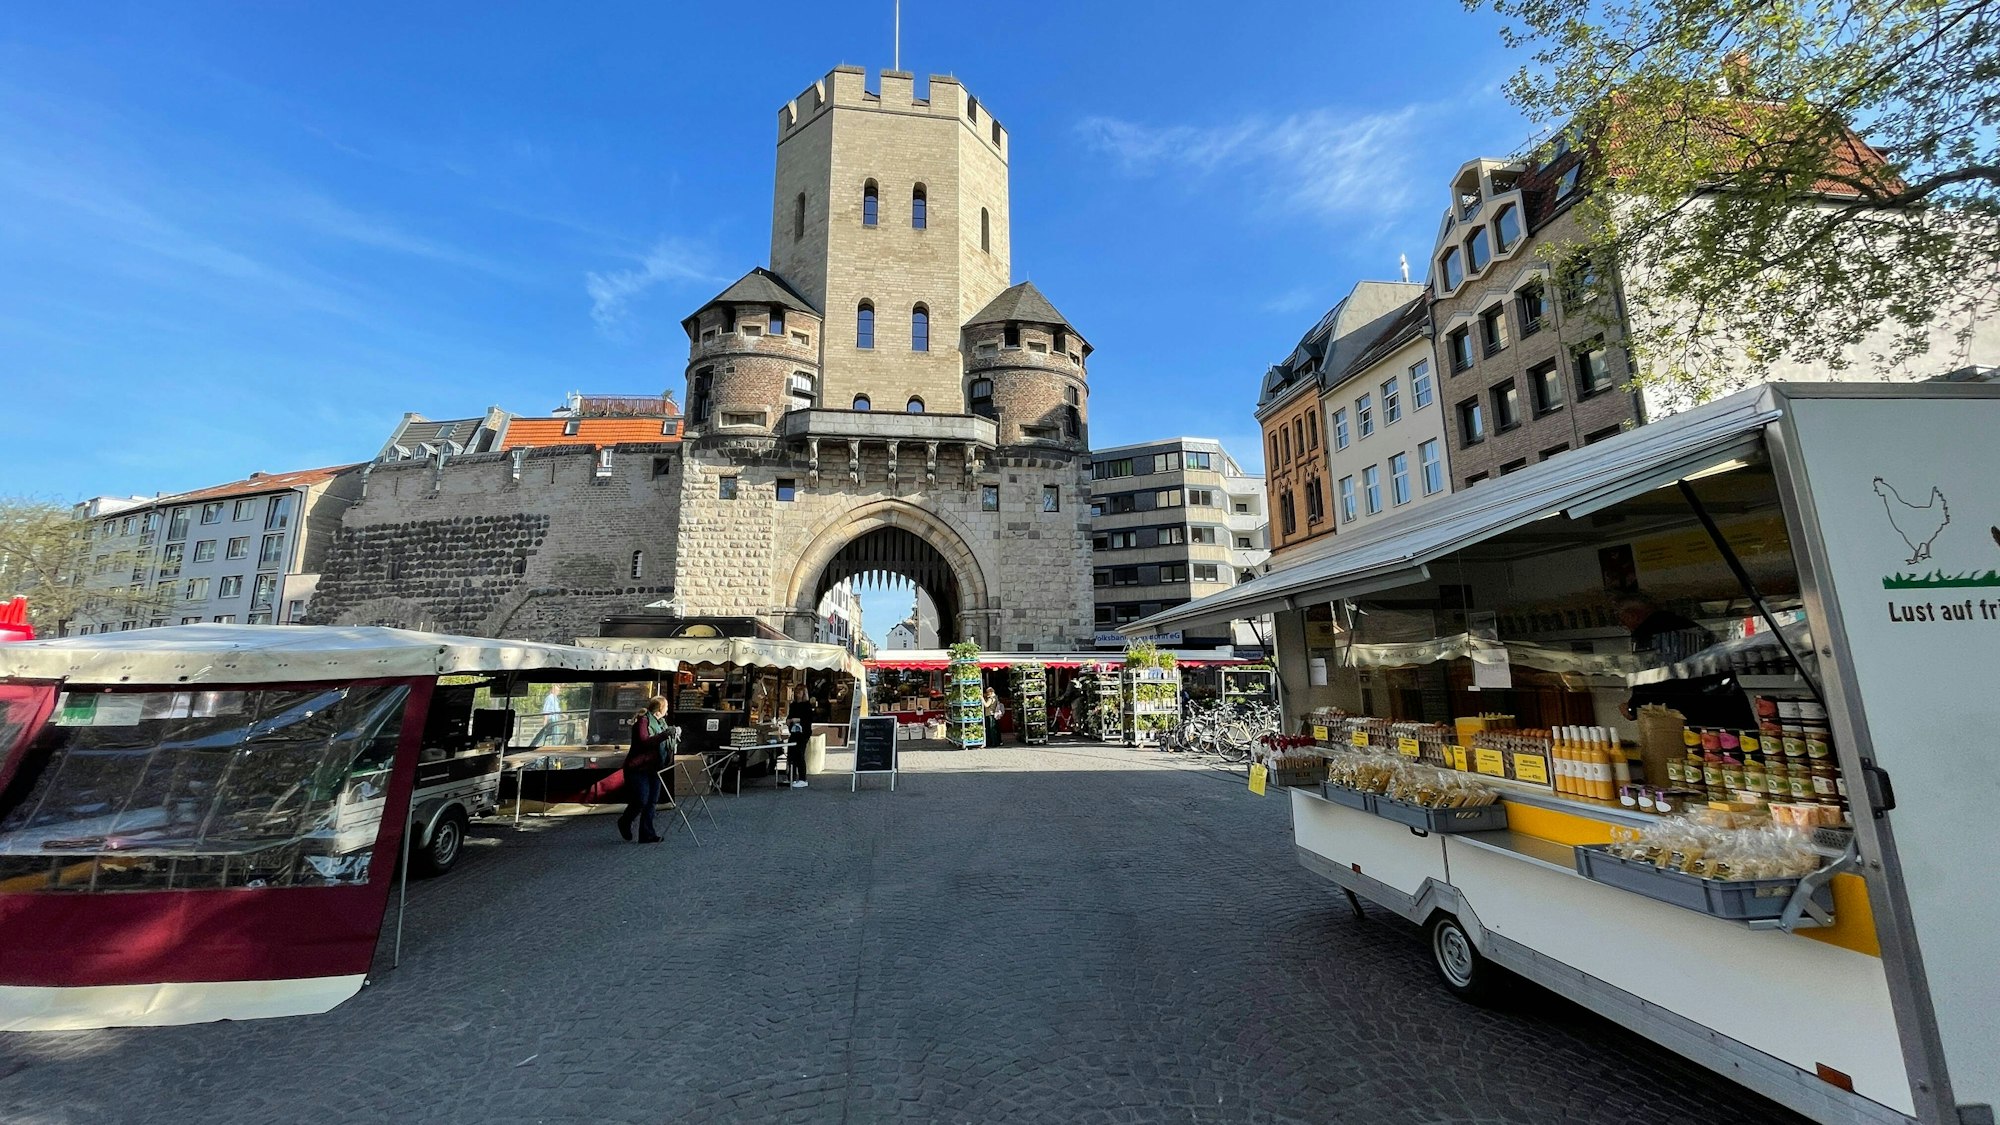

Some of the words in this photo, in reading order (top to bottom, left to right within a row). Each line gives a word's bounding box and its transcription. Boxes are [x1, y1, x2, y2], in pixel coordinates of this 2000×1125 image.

[1888, 602, 1935, 622] Lust
[1941, 600, 1973, 621] auf
[1980, 599, 2000, 620] fr
